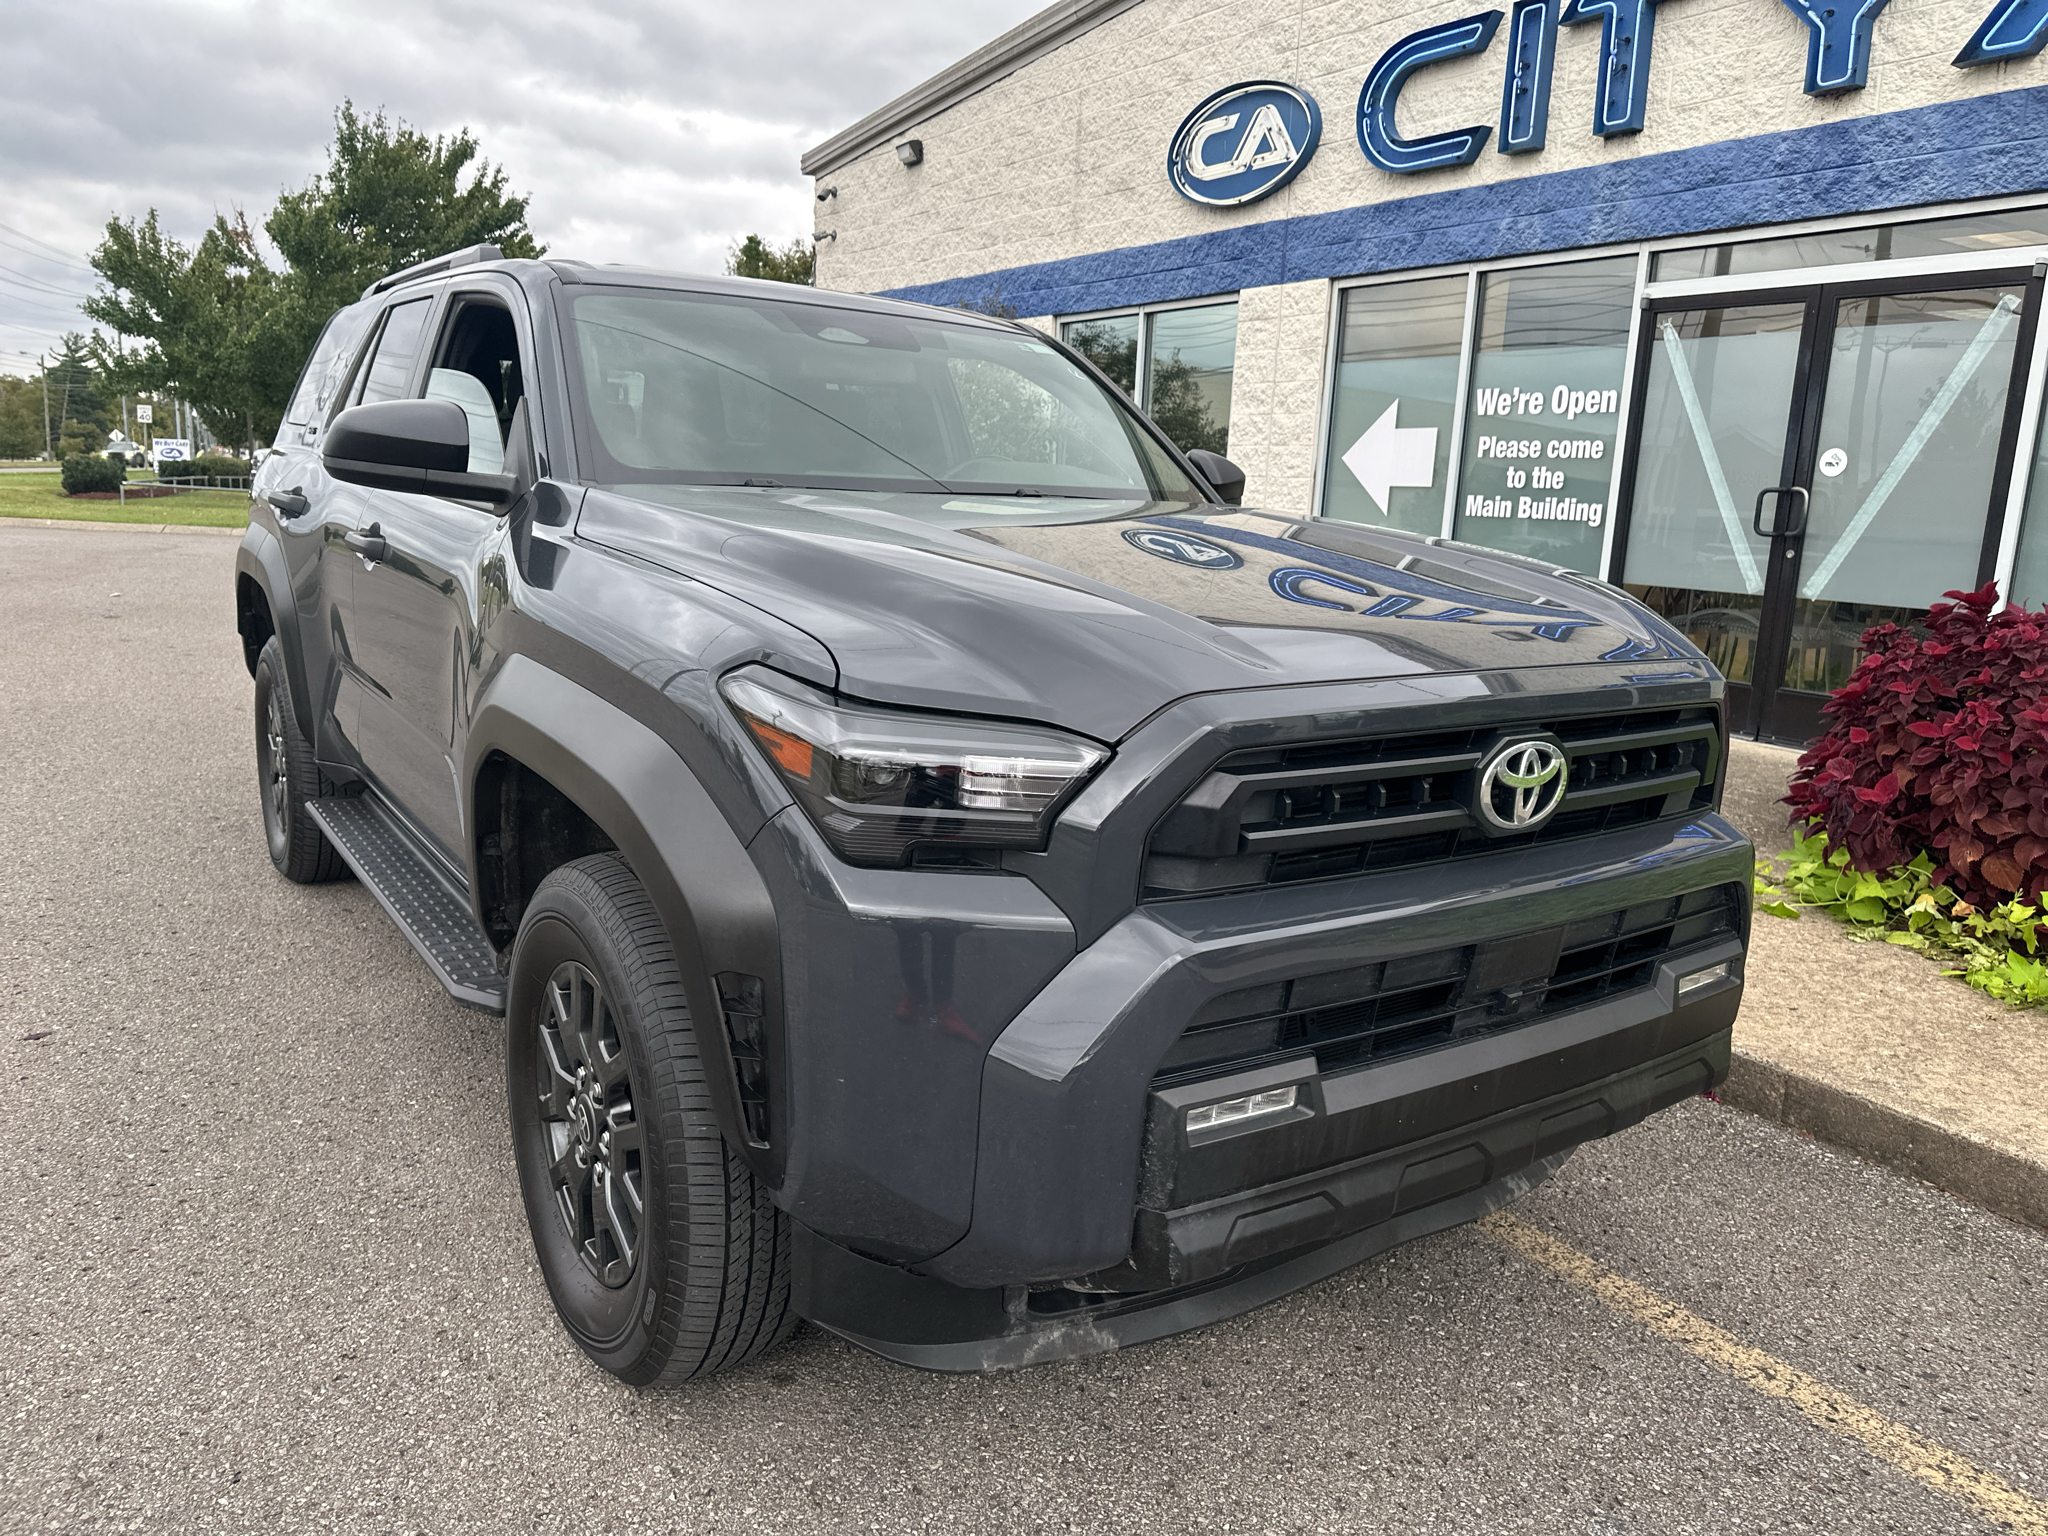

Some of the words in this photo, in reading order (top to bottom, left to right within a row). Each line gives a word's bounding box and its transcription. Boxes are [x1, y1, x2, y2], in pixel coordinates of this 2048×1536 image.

[1185, 104, 1299, 181] CA
[1476, 387, 1544, 416] We're
[1551, 385, 1618, 420] Open
[139, 413, 151, 421] 40
[1477, 436, 1541, 458] Please
[1547, 439, 1604, 459] come
[1506, 466, 1526, 489] to
[1532, 466, 1565, 489] the
[1465, 495, 1512, 518] Main
[1517, 496, 1603, 527] Building
